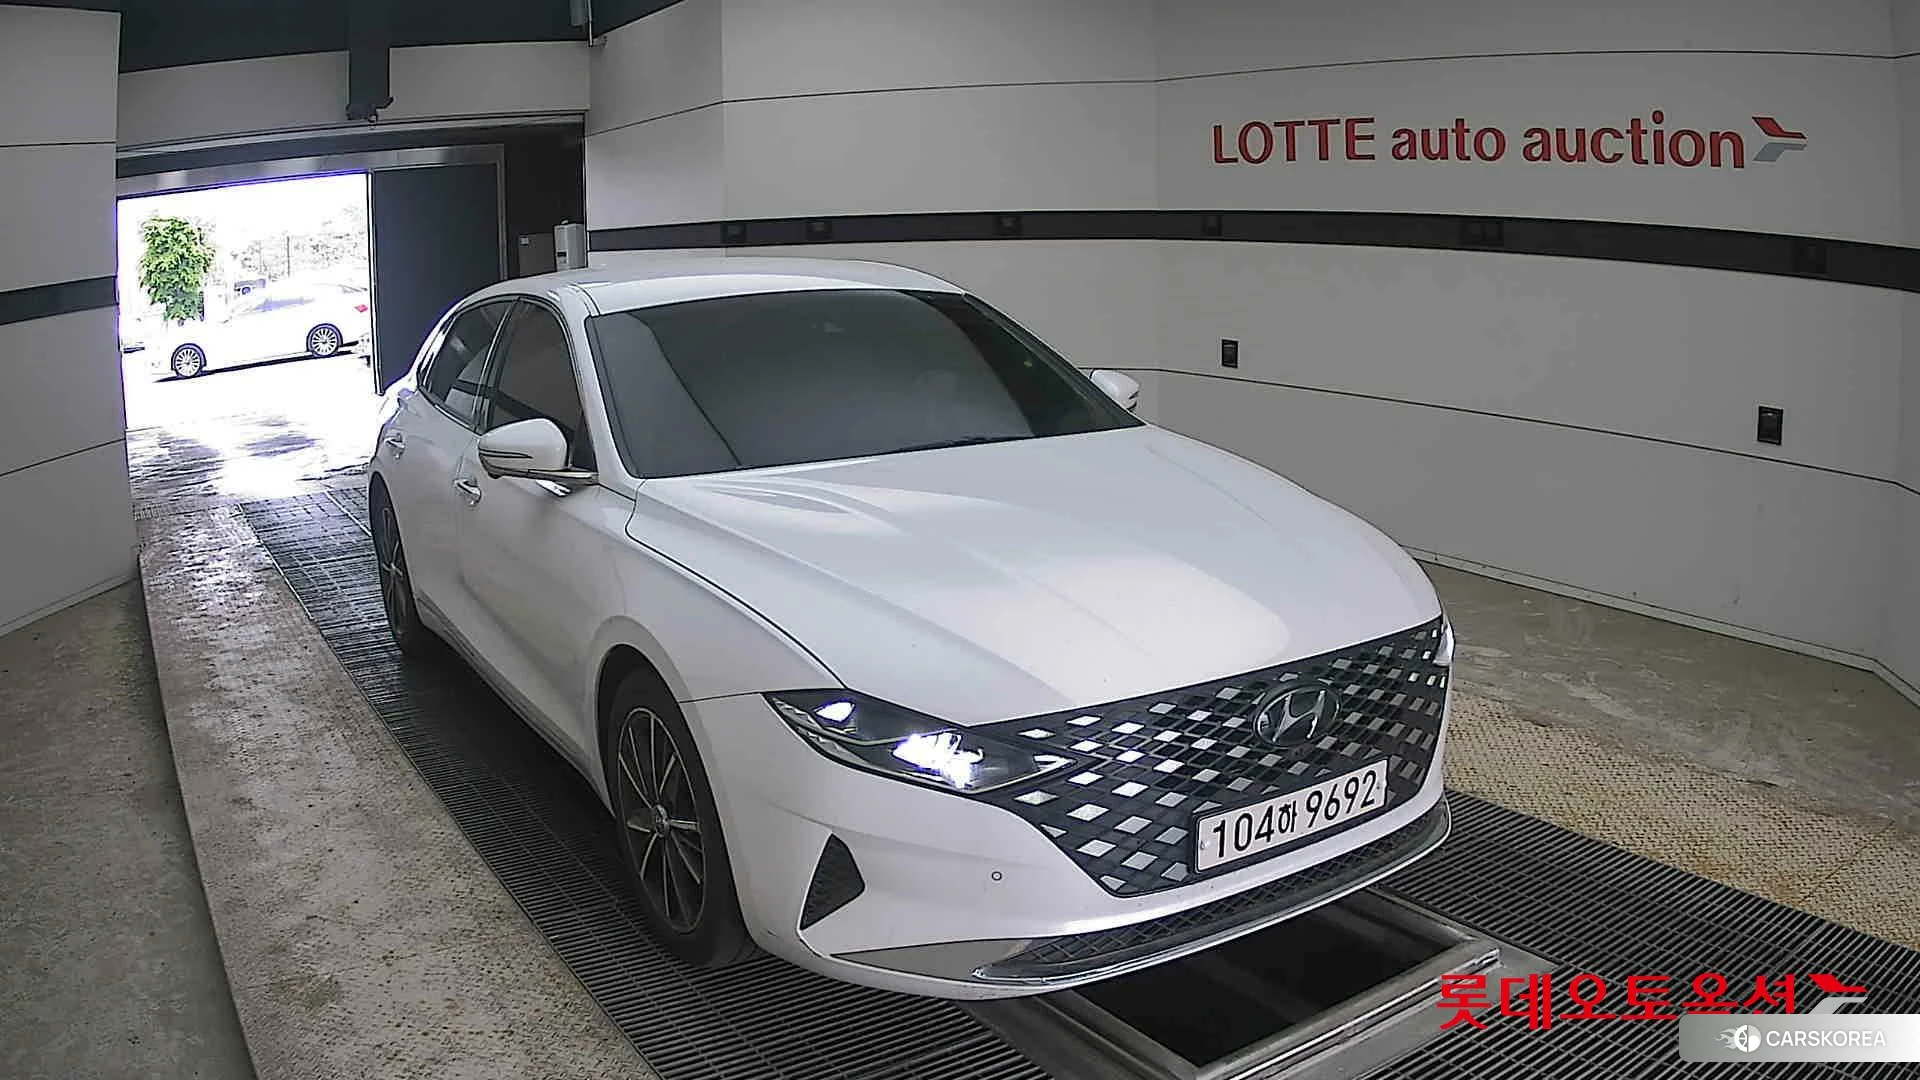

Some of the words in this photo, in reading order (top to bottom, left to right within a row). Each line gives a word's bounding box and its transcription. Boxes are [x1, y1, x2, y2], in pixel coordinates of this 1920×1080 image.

[1213, 117, 1376, 163] LOTTE
[1391, 117, 1507, 162] auto
[1522, 110, 1745, 169] auction
[1213, 800, 1298, 858] 104하
[1305, 769, 1377, 829] 9692
